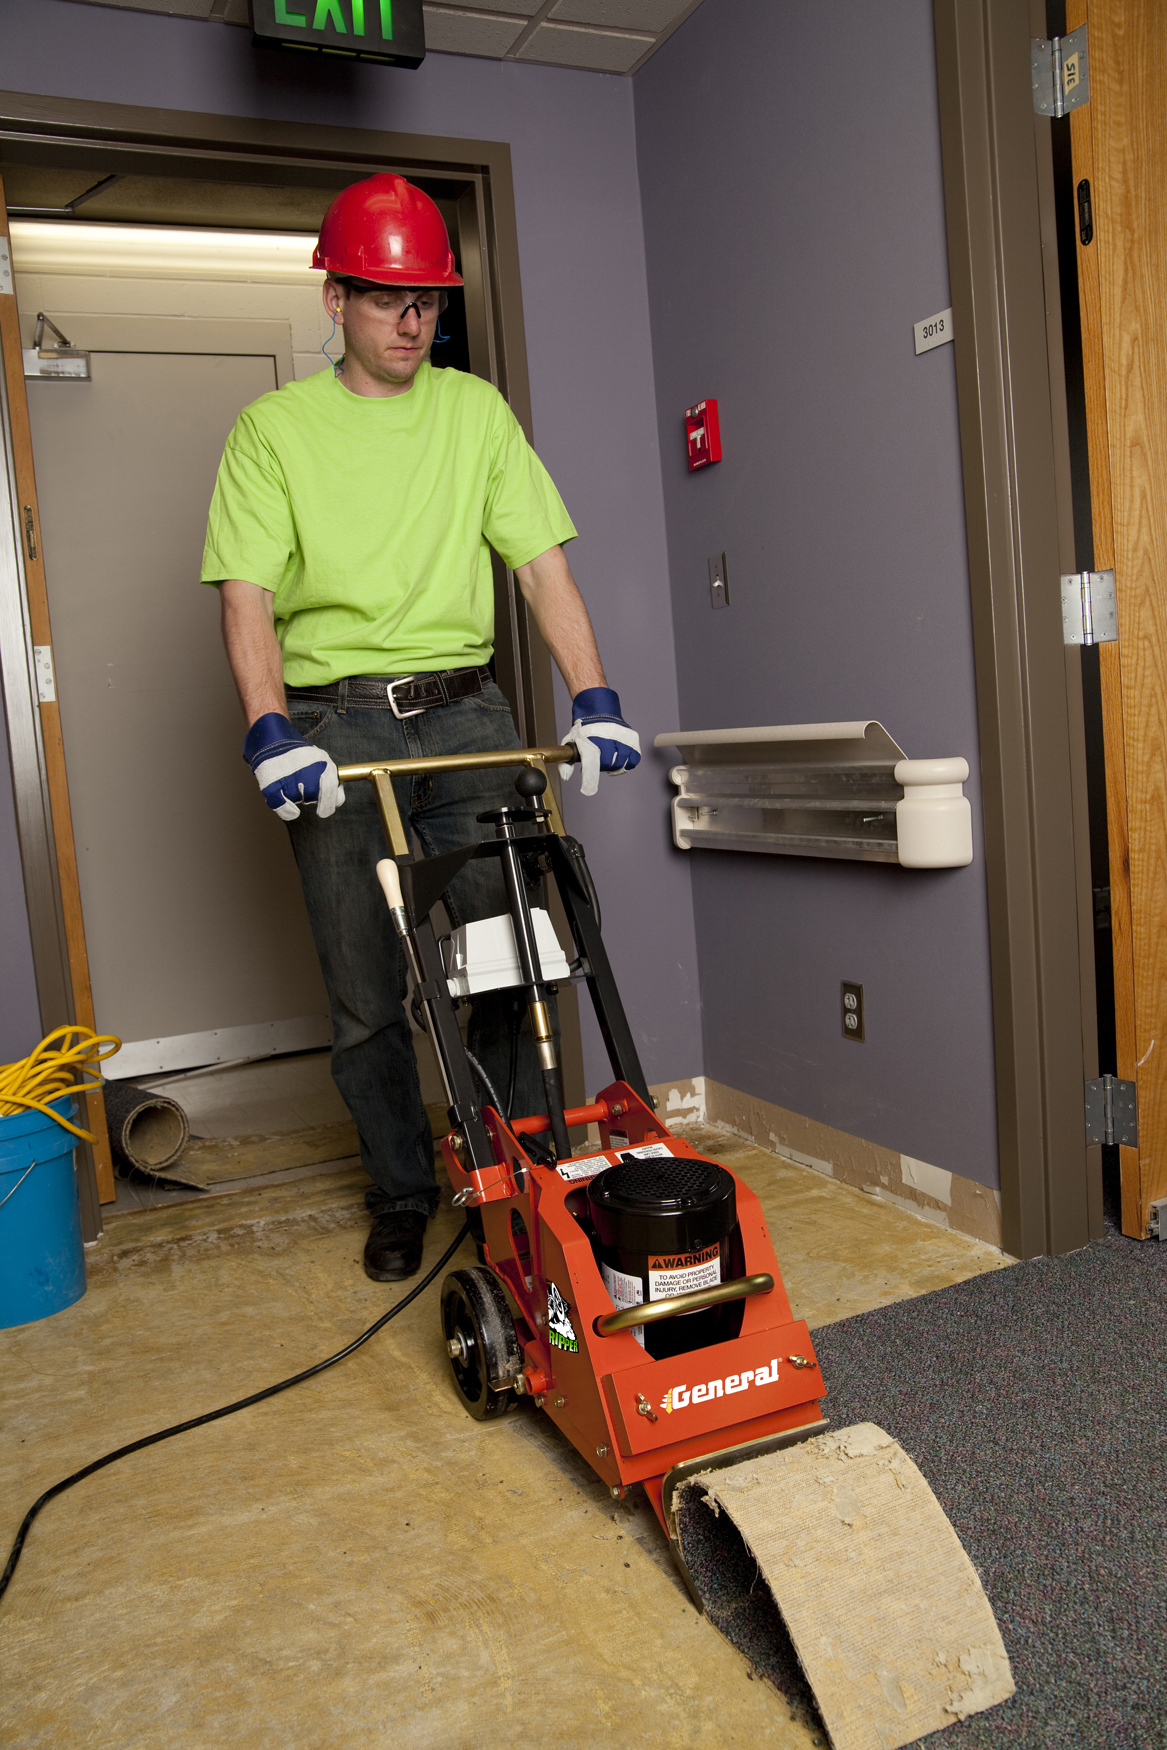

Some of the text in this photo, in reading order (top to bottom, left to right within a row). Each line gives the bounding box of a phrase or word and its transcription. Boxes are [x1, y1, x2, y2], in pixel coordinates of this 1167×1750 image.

[922, 319, 945, 339] 3013
[662, 1246, 719, 1269] WARNING
[668, 1272, 687, 1280] AVOID
[687, 1264, 715, 1277] PROPERTY
[692, 1270, 717, 1283] PERSONAL
[678, 1282, 702, 1291] REMOVE
[702, 1275, 718, 1288] BLADE
[672, 1358, 779, 1410] General
